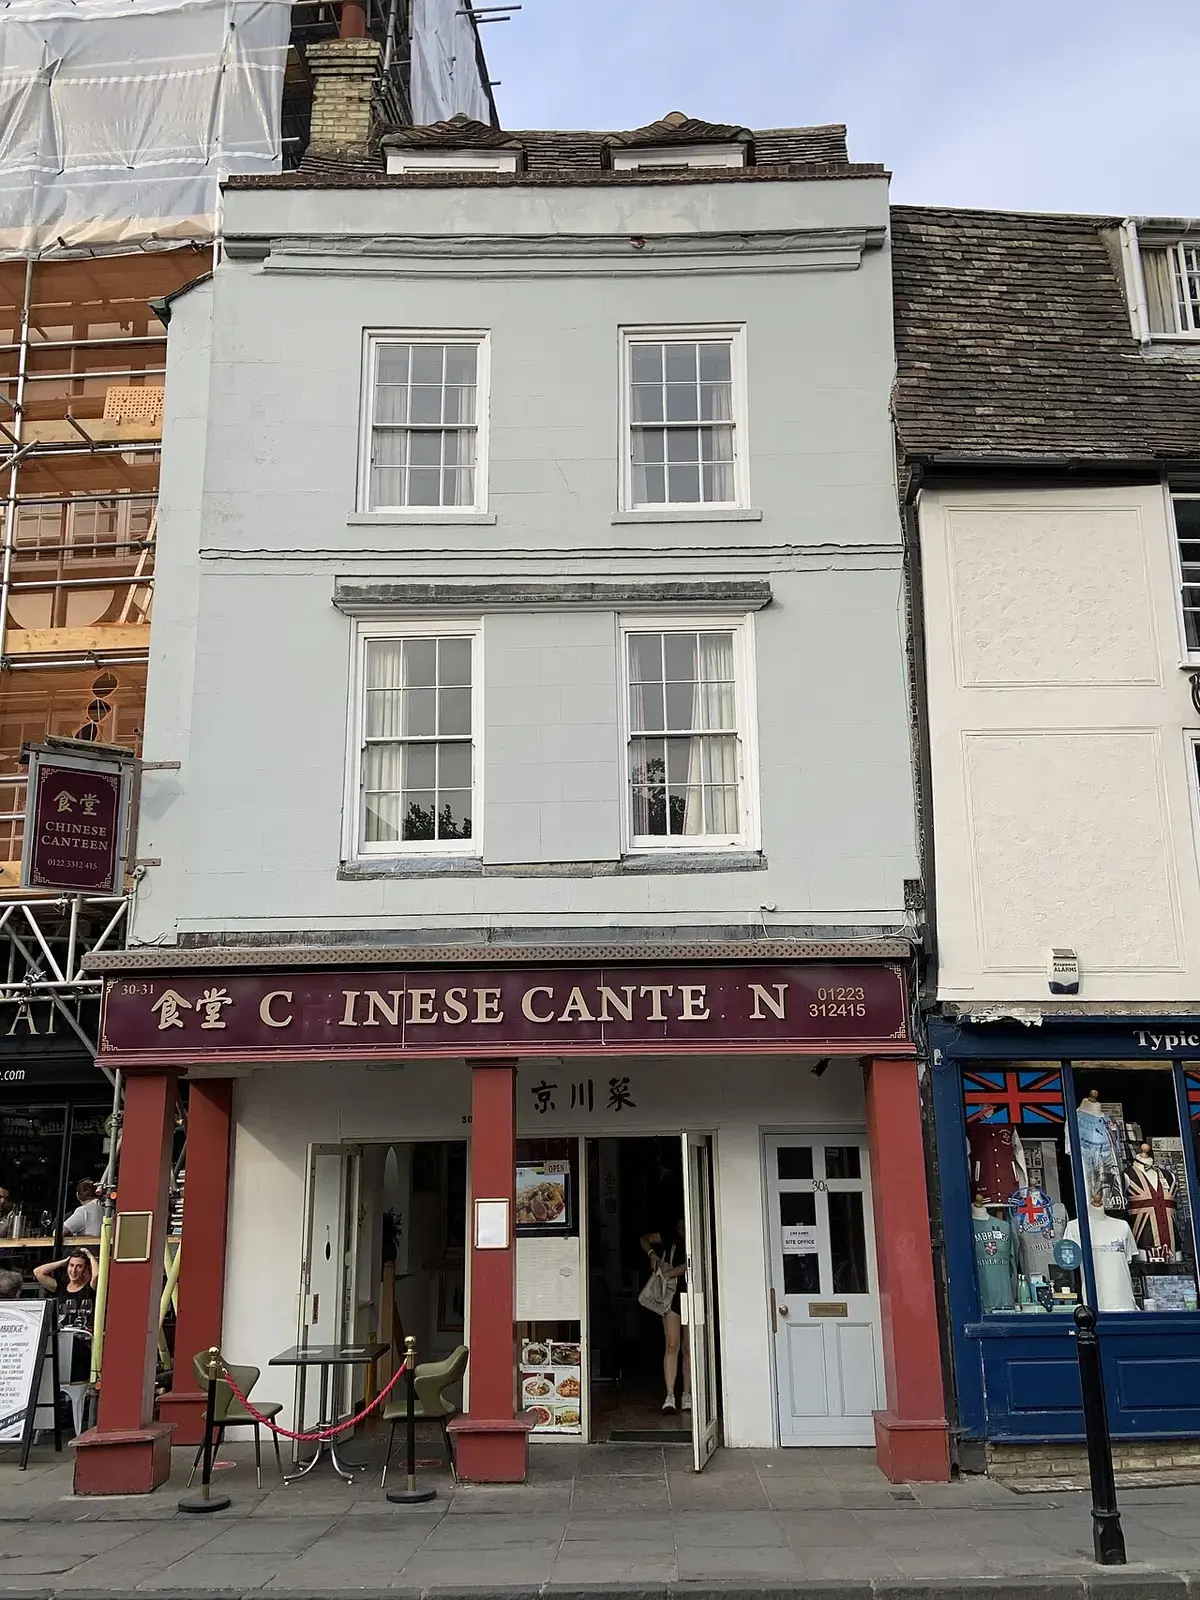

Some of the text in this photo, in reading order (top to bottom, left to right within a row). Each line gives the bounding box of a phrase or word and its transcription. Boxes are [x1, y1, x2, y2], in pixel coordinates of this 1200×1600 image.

[53, 789, 101, 816] 食堂
[45, 821, 107, 837] CHINESE
[41, 835, 109, 851] CANTEEN
[121, 983, 155, 996] 30-31
[817, 987, 865, 1002] 01223
[150, 987, 233, 1031] 食堂
[809, 1002, 866, 1018] 312415
[1132, 1030, 1200, 1051] Typic
[0, 1069, 26, 1081] .com
[530, 1076, 637, 1115] 京川菜
[548, 1164, 565, 1173] OPEN
